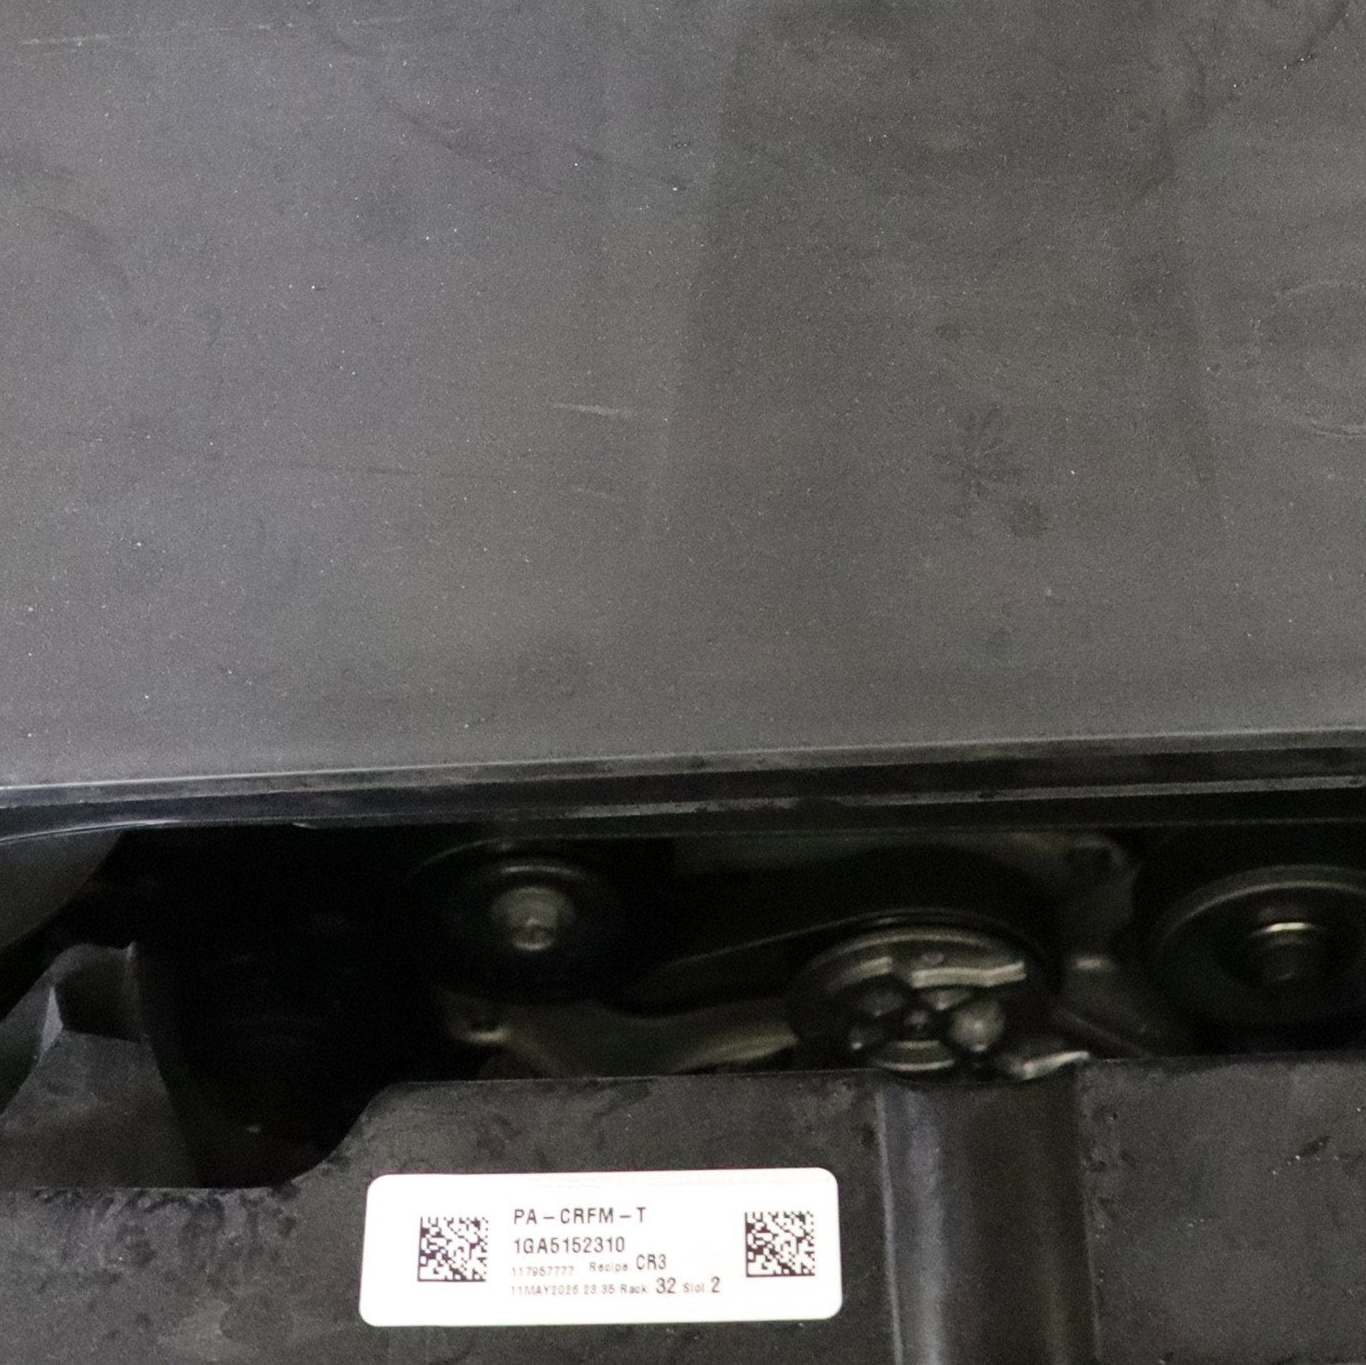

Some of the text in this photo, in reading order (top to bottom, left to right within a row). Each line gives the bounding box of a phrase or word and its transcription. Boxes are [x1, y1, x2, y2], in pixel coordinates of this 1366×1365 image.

[514, 1236, 626, 1254] 1GA5152310
[636, 1254, 667, 1271] CR3
[656, 1277, 677, 1294] 32
[711, 1276, 722, 1294] 2
